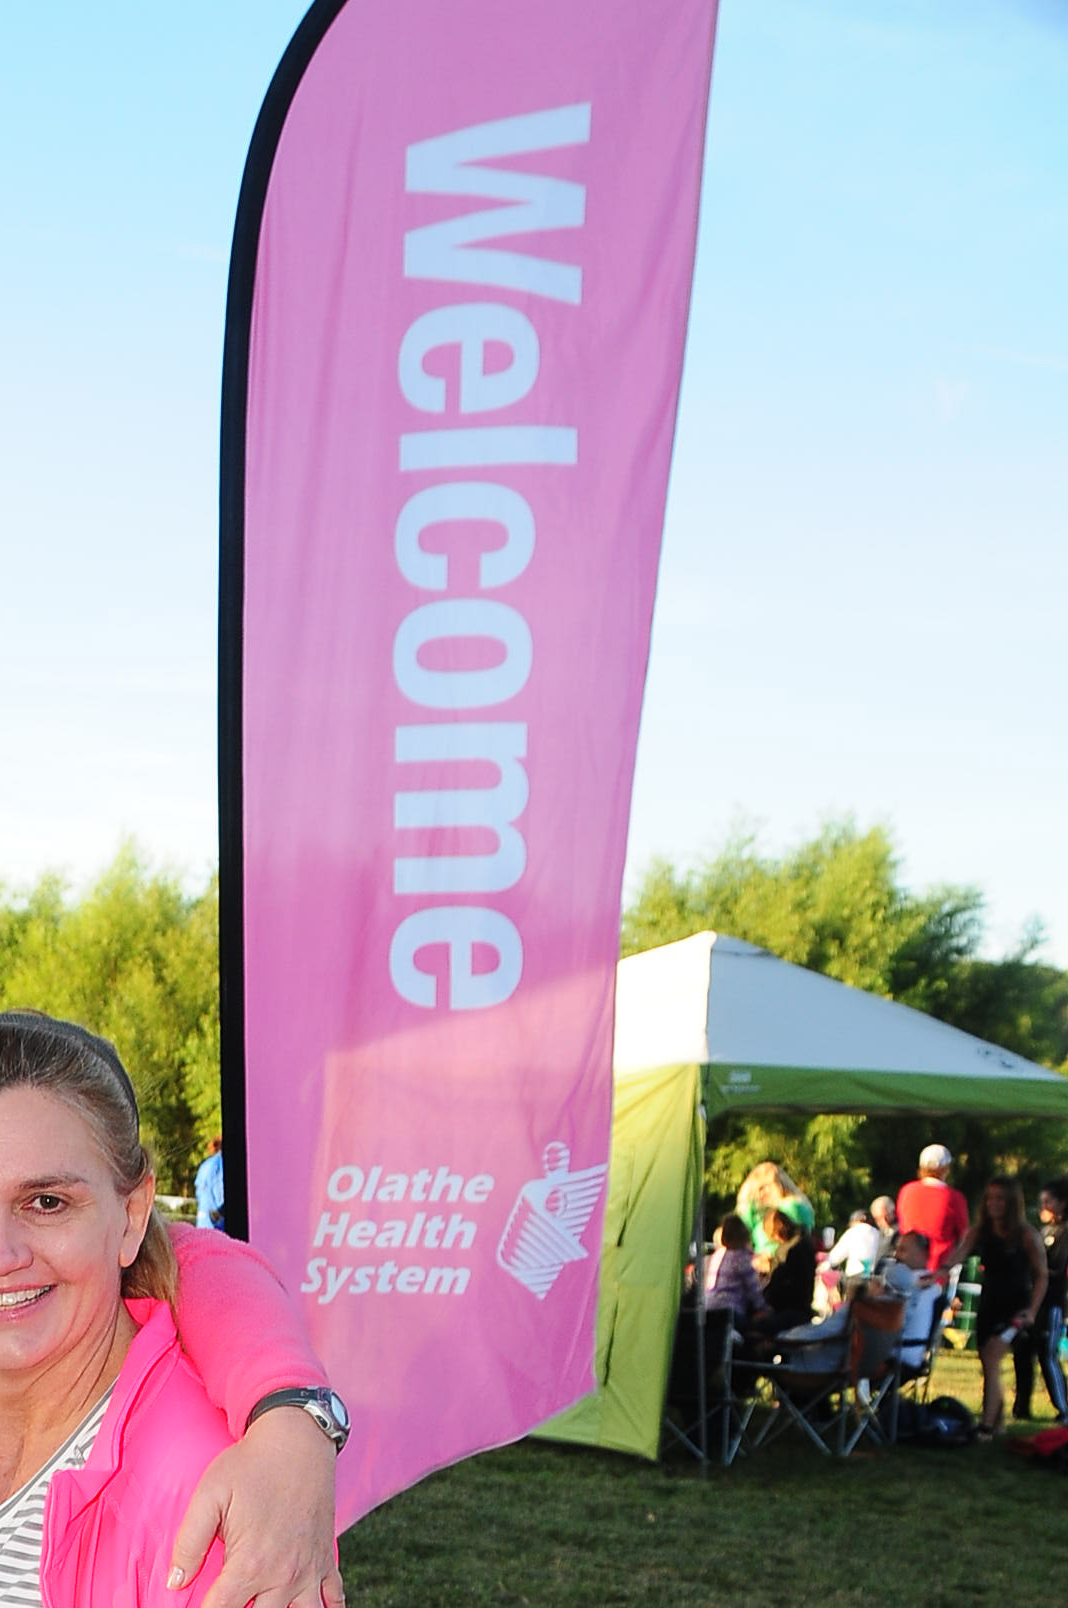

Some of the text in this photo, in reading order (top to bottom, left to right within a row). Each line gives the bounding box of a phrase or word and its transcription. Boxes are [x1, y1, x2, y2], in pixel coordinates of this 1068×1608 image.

[389, 101, 592, 1012] Welcome
[327, 1165, 495, 1202] Olathe
[313, 1212, 477, 1249] Health
[300, 1257, 471, 1304] System
